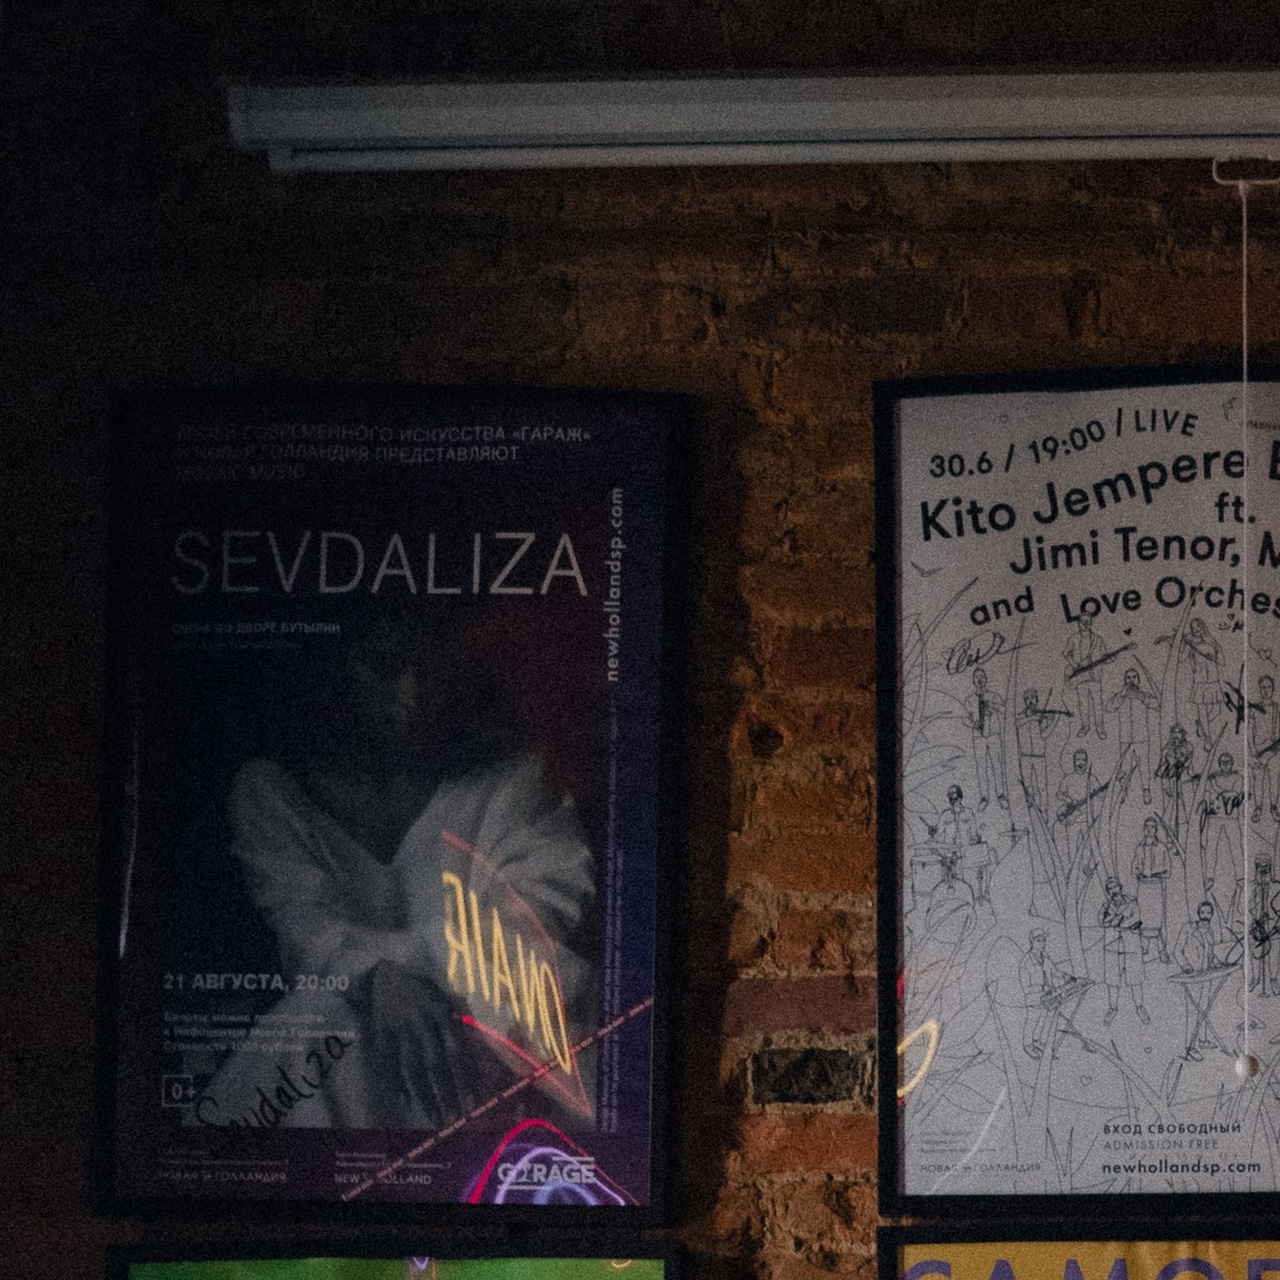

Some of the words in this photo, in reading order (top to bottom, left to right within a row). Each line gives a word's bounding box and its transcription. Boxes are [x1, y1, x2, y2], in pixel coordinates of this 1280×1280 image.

[400, 426, 505, 443] ИСКУССТВА
[513, 425, 591, 443] «ГАРАЖ»
[929, 453, 993, 479] 30.6
[1003, 444, 1015, 472] /
[1028, 420, 1105, 465] 19:00
[1135, 409, 1199, 437] LIVE
[375, 444, 520, 465] ПРЕДСТАВЛЯЮТ
[920, 497, 1016, 541] Kito
[1033, 447, 1246, 525] Jempere
[1214, 492, 1256, 523] ft.
[172, 531, 588, 597] SEVDALIZA
[1010, 529, 1100, 575] Jimi
[1114, 526, 1240, 567] Tenor,
[605, 485, 626, 683] newhollandsp.com
[969, 586, 1035, 627] and
[1060, 587, 1142, 624] Love
[163, 974, 185, 990] 21
[191, 973, 290, 992] АВГУСТА,
[295, 974, 350, 991] 20:00
[1103, 1120, 1142, 1139] ВХОД
[1148, 1120, 1242, 1138] СВОБОДНЫЙ
[1103, 1139, 1184, 1151] ADMISSION
[1189, 1138, 1219, 1150] FREE
[1103, 1157, 1262, 1176] newhollandsp.com
